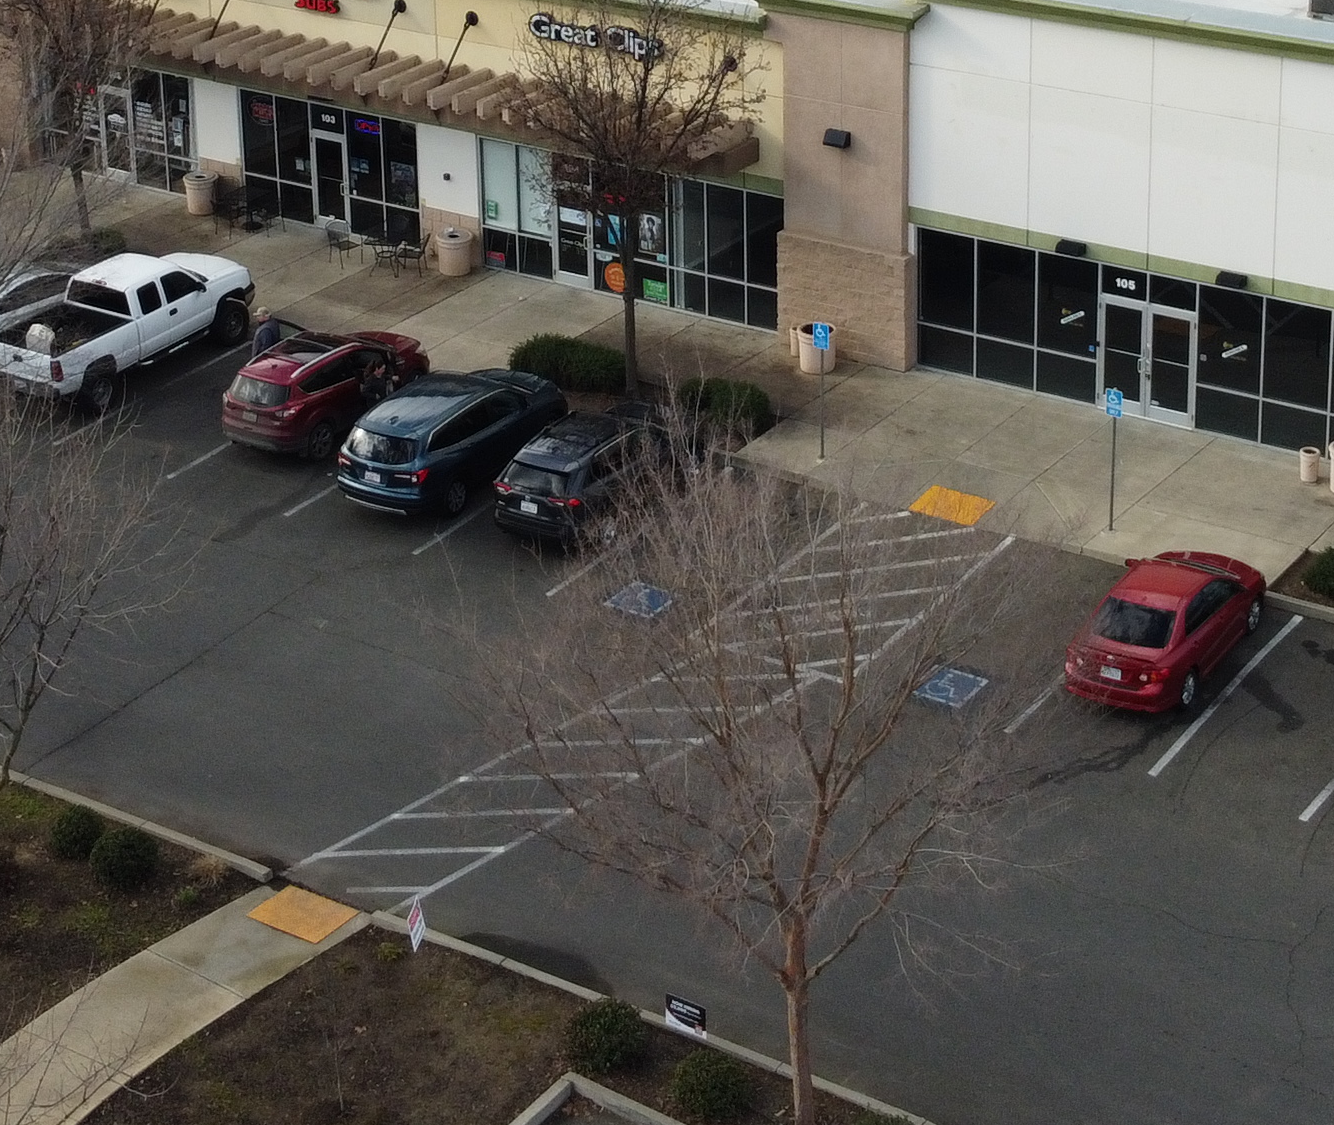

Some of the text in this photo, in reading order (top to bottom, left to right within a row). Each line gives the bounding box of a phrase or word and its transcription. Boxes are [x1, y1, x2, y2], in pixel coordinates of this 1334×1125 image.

[529, 14, 661, 61] Great Clips
[321, 113, 336, 124] 103
[1115, 277, 1136, 291] 105
